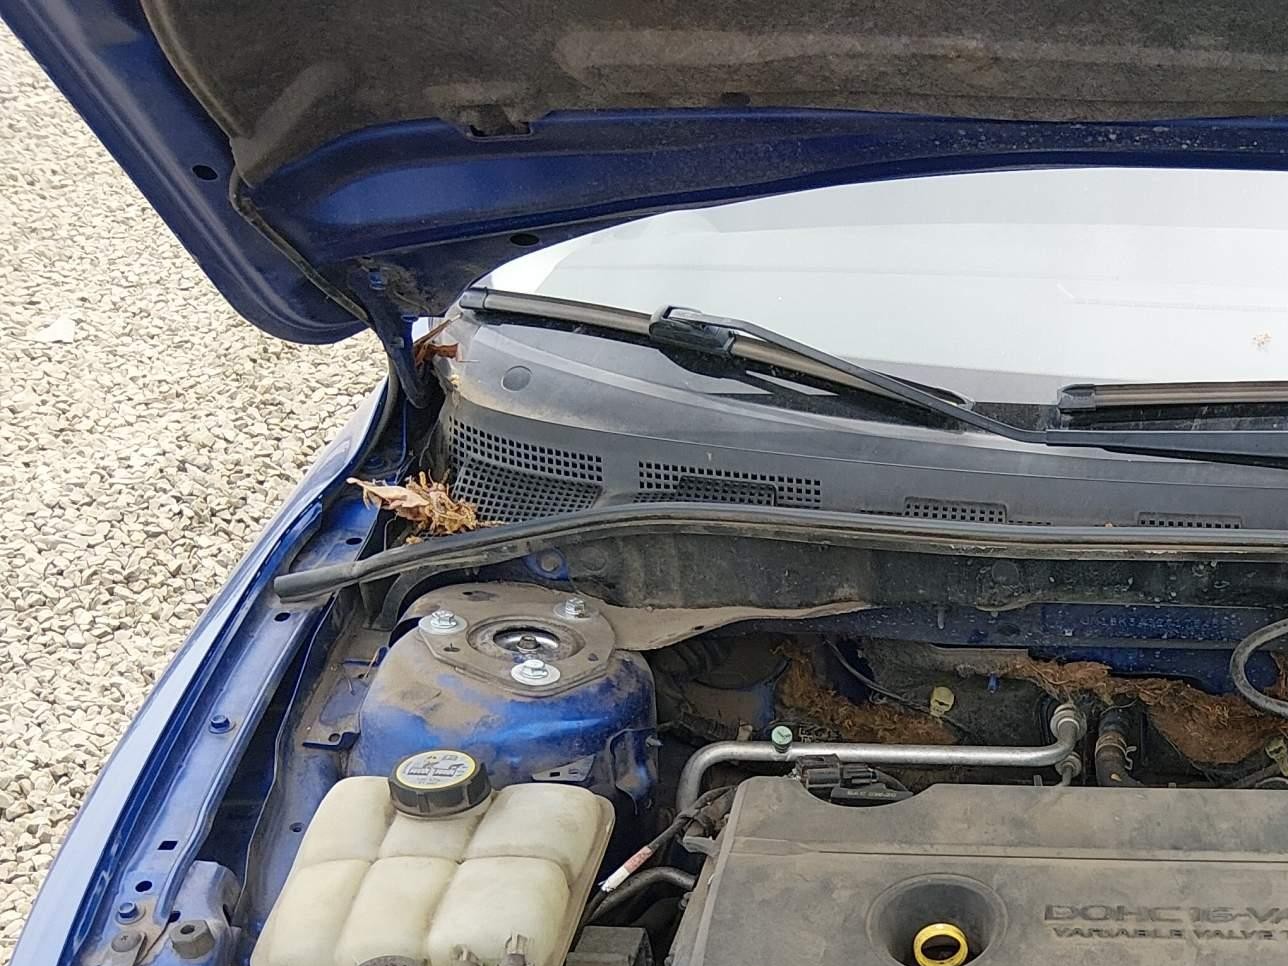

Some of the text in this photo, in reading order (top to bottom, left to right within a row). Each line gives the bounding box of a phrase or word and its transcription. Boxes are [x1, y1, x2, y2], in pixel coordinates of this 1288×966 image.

[1044, 905, 1182, 922] DOHC
[1052, 927, 1184, 939] VARIABLE
[1192, 929, 1273, 940] VALVE
